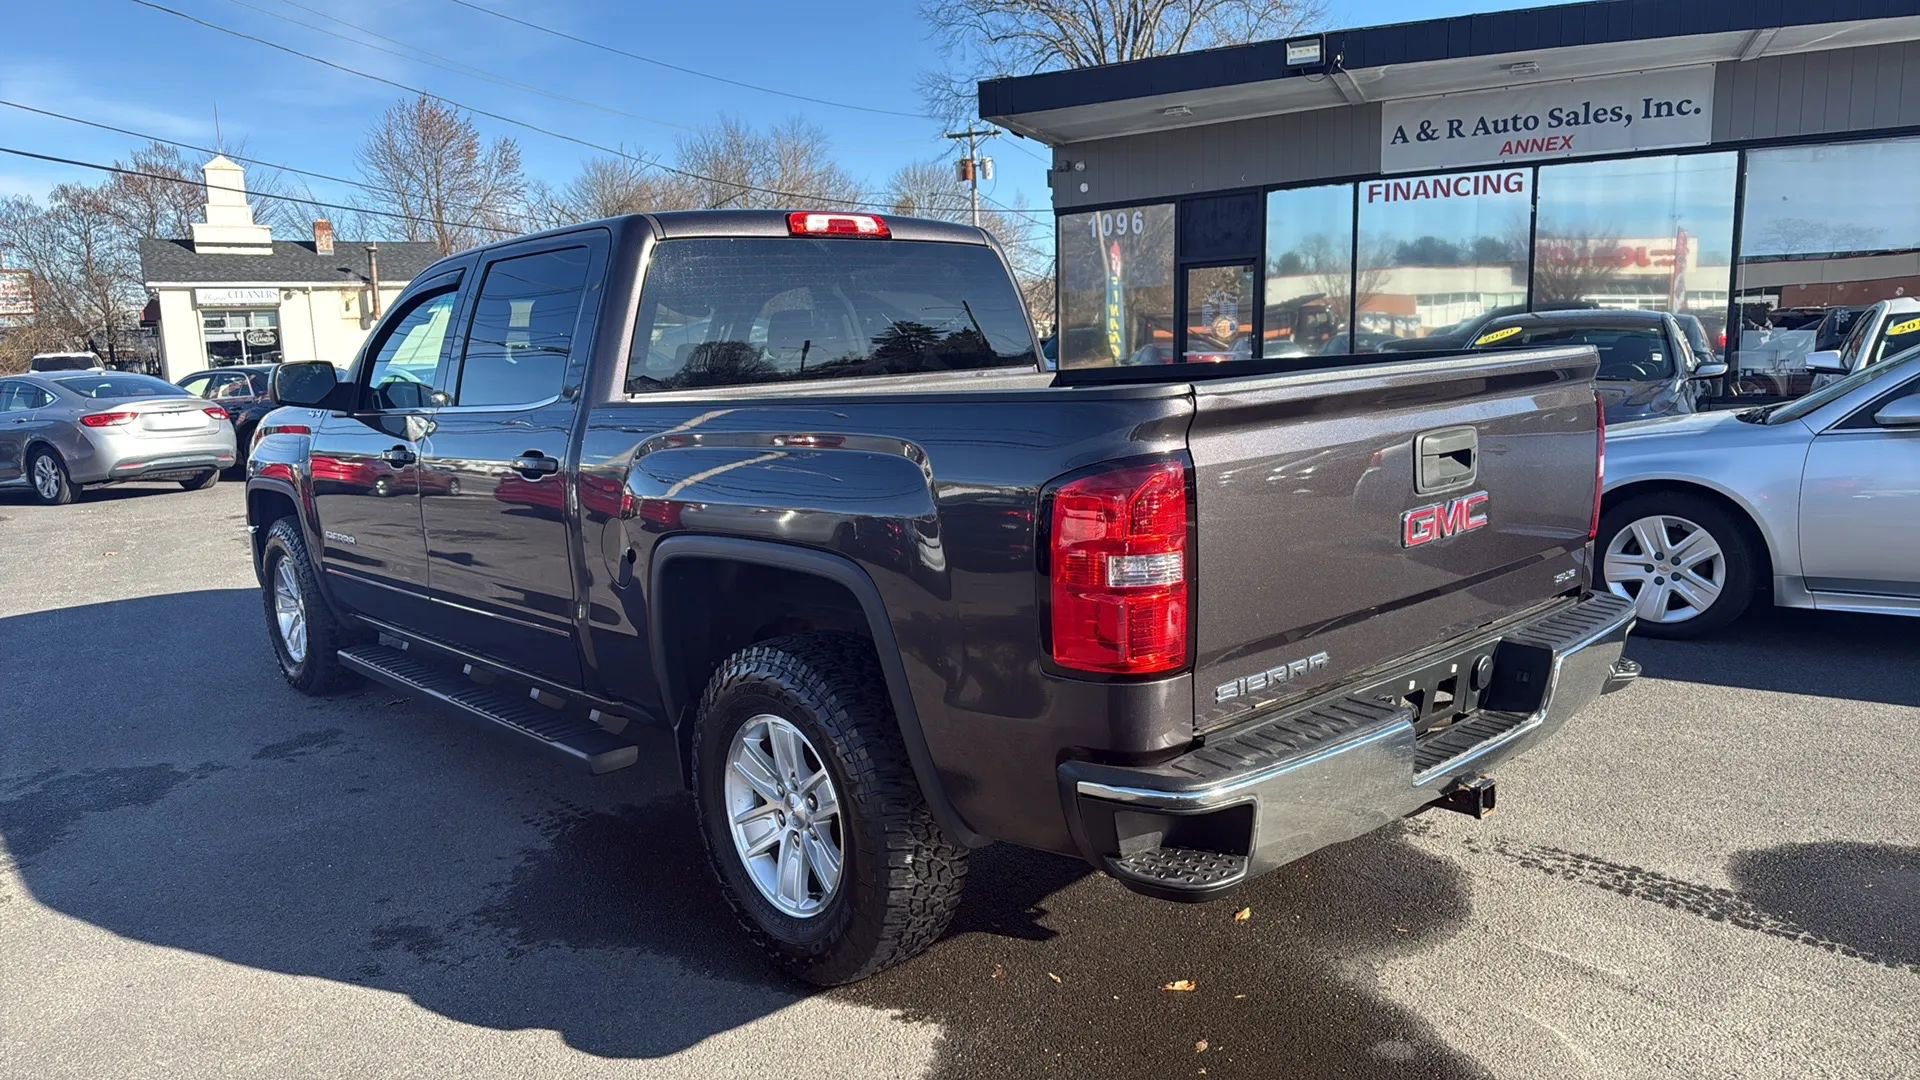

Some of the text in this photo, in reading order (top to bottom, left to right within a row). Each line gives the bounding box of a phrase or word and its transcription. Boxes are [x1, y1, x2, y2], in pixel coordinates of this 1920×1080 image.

[1390, 97, 1702, 145] A & R Auto Sales, Inc.
[1499, 134, 1575, 156] ANNEX
[1367, 172, 1525, 204] FINANCING
[1087, 210, 1144, 238] 1096
[1400, 490, 1489, 550] GMC
[1214, 651, 1329, 704] SIERRA
